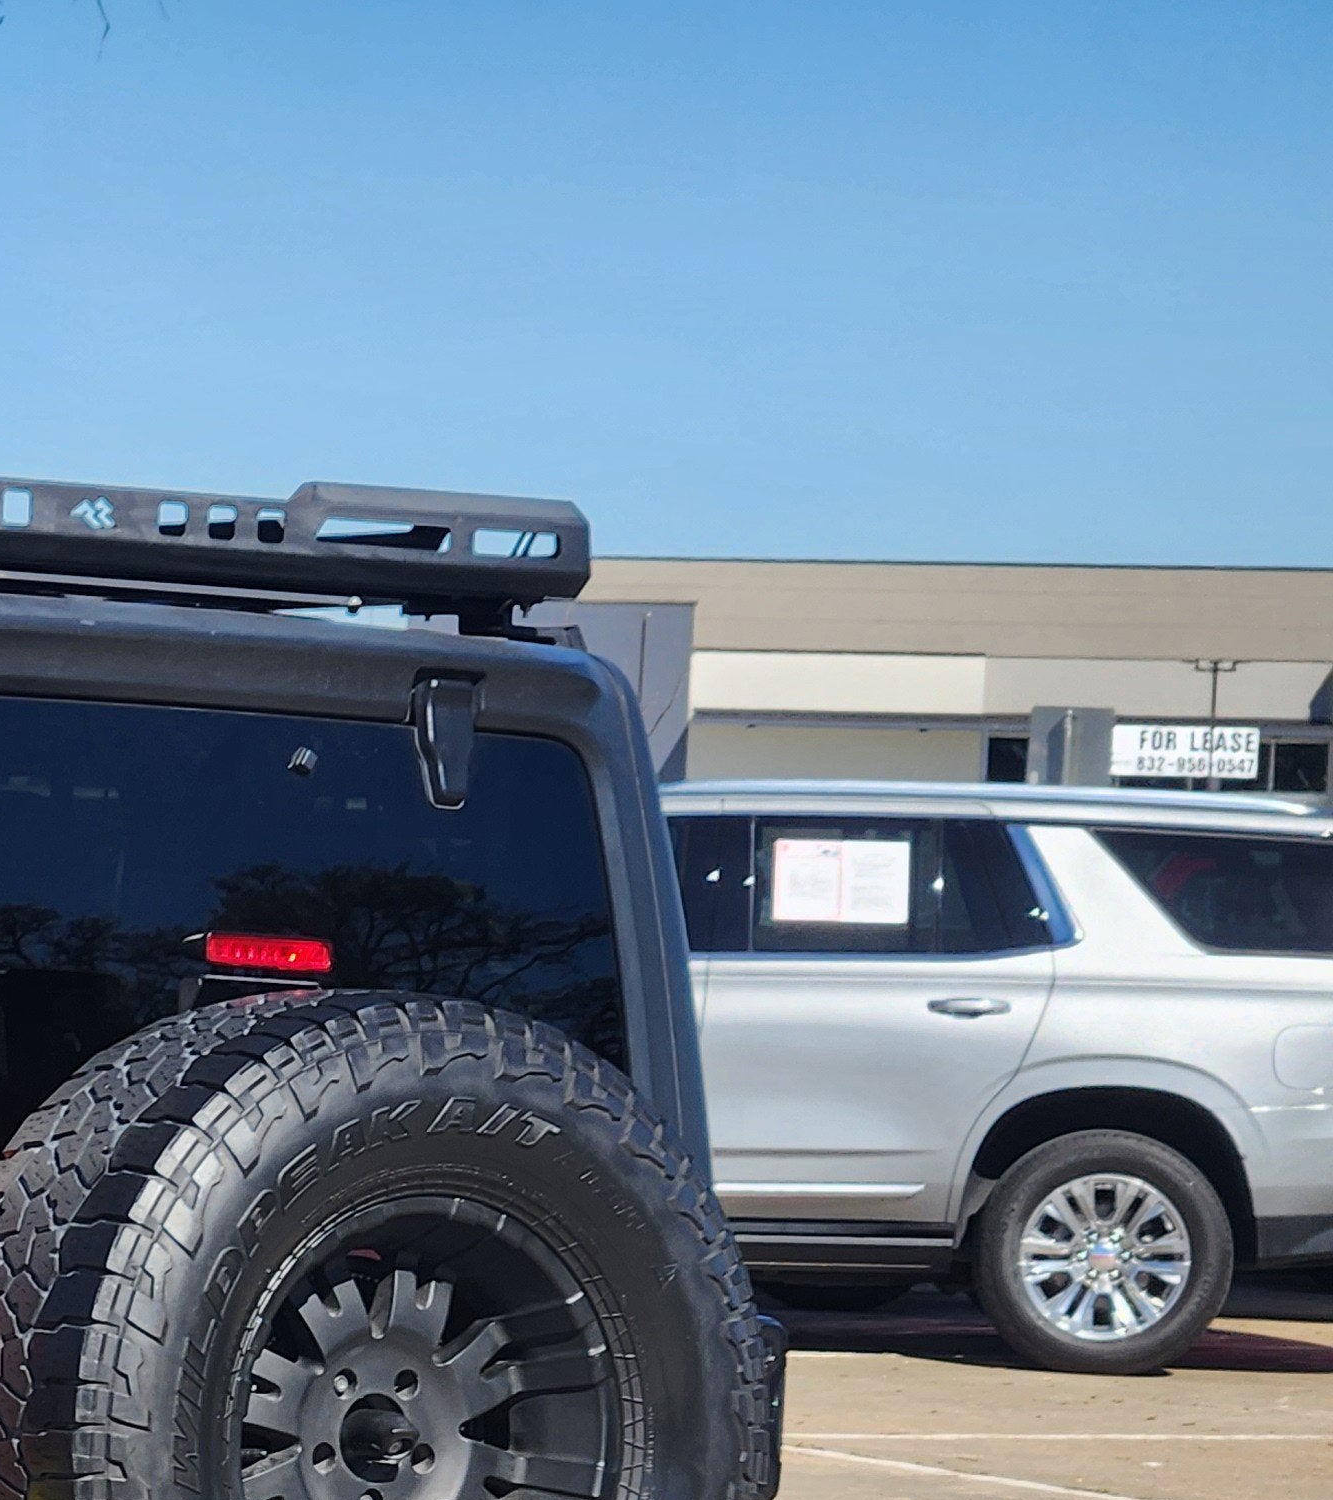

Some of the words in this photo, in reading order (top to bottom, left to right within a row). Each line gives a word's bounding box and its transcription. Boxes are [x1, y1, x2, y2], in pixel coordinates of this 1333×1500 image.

[1139, 729, 1177, 751] FOR
[1189, 730, 1259, 753] LEASE
[173, 1098, 422, 1492] WILDPEAK
